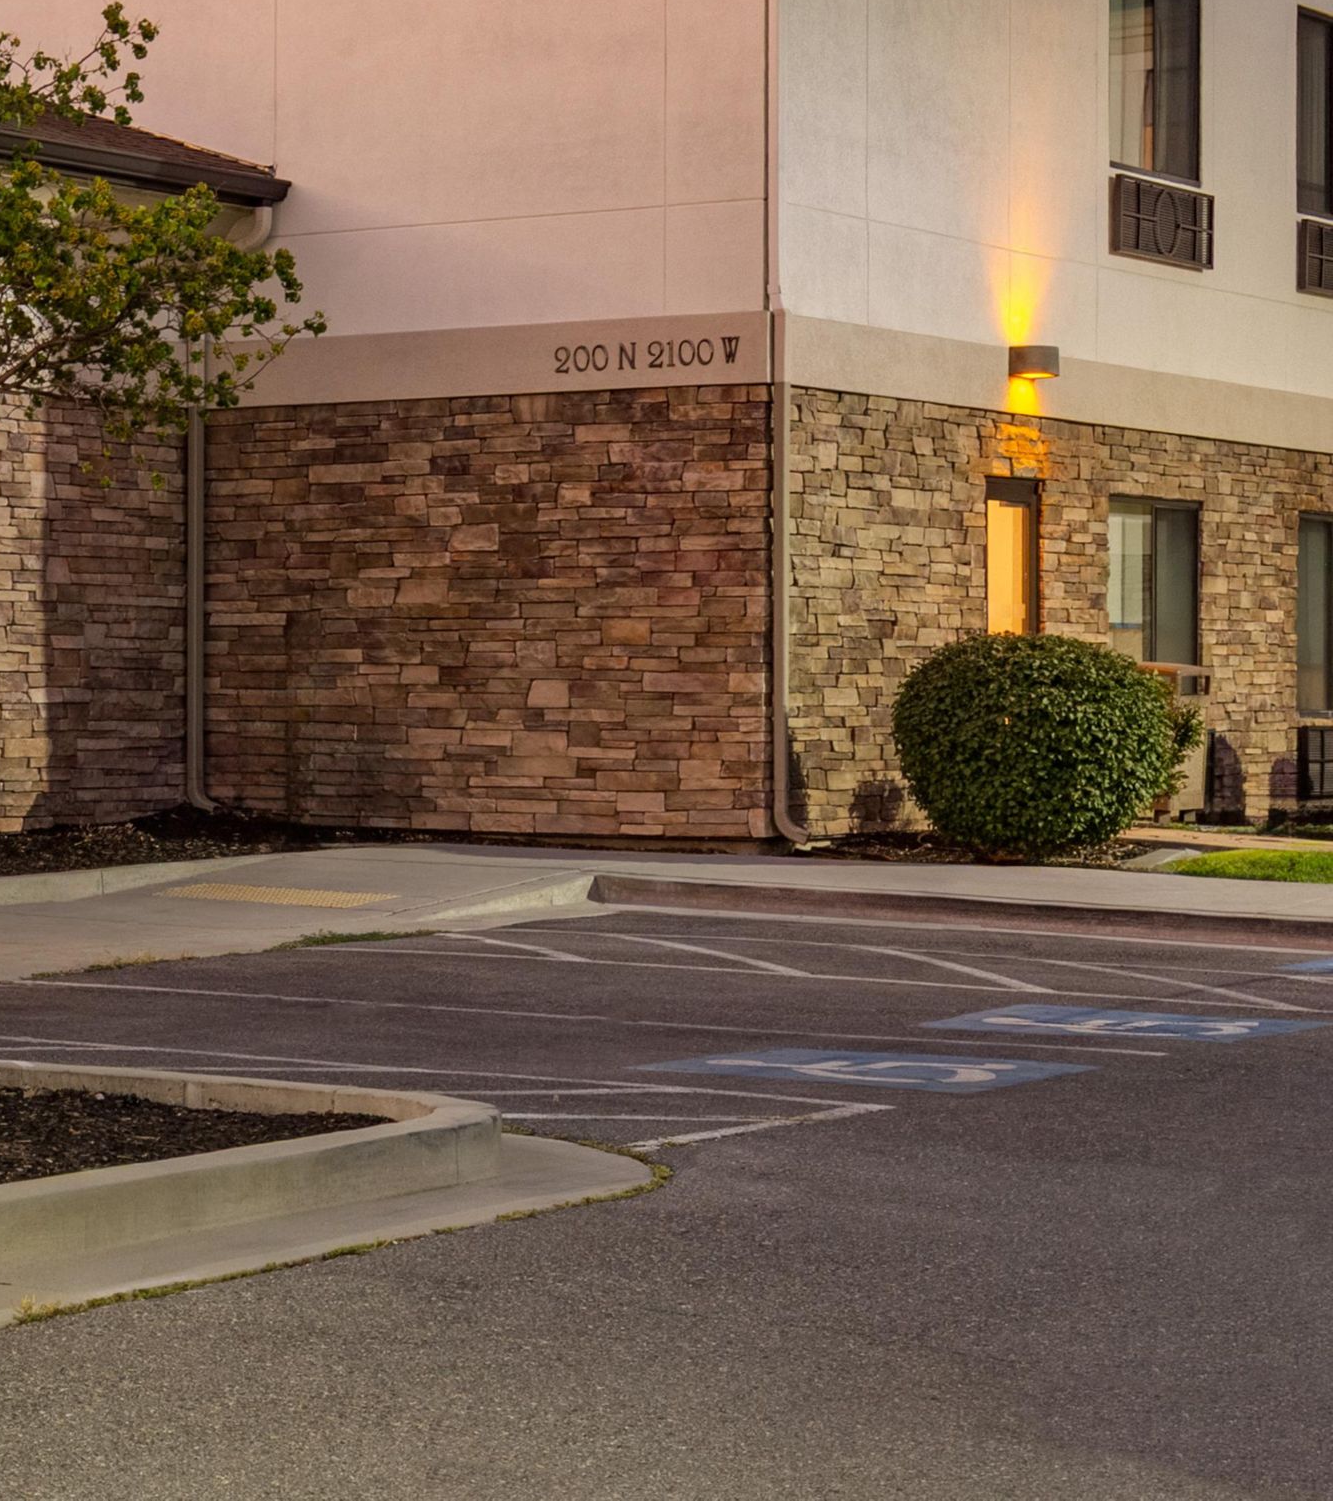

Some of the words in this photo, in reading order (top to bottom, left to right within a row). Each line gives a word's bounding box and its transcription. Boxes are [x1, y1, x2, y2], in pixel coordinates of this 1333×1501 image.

[554, 344, 609, 375] 200
[617, 341, 637, 371] N
[647, 337, 715, 369] 2100
[721, 335, 741, 365] W
